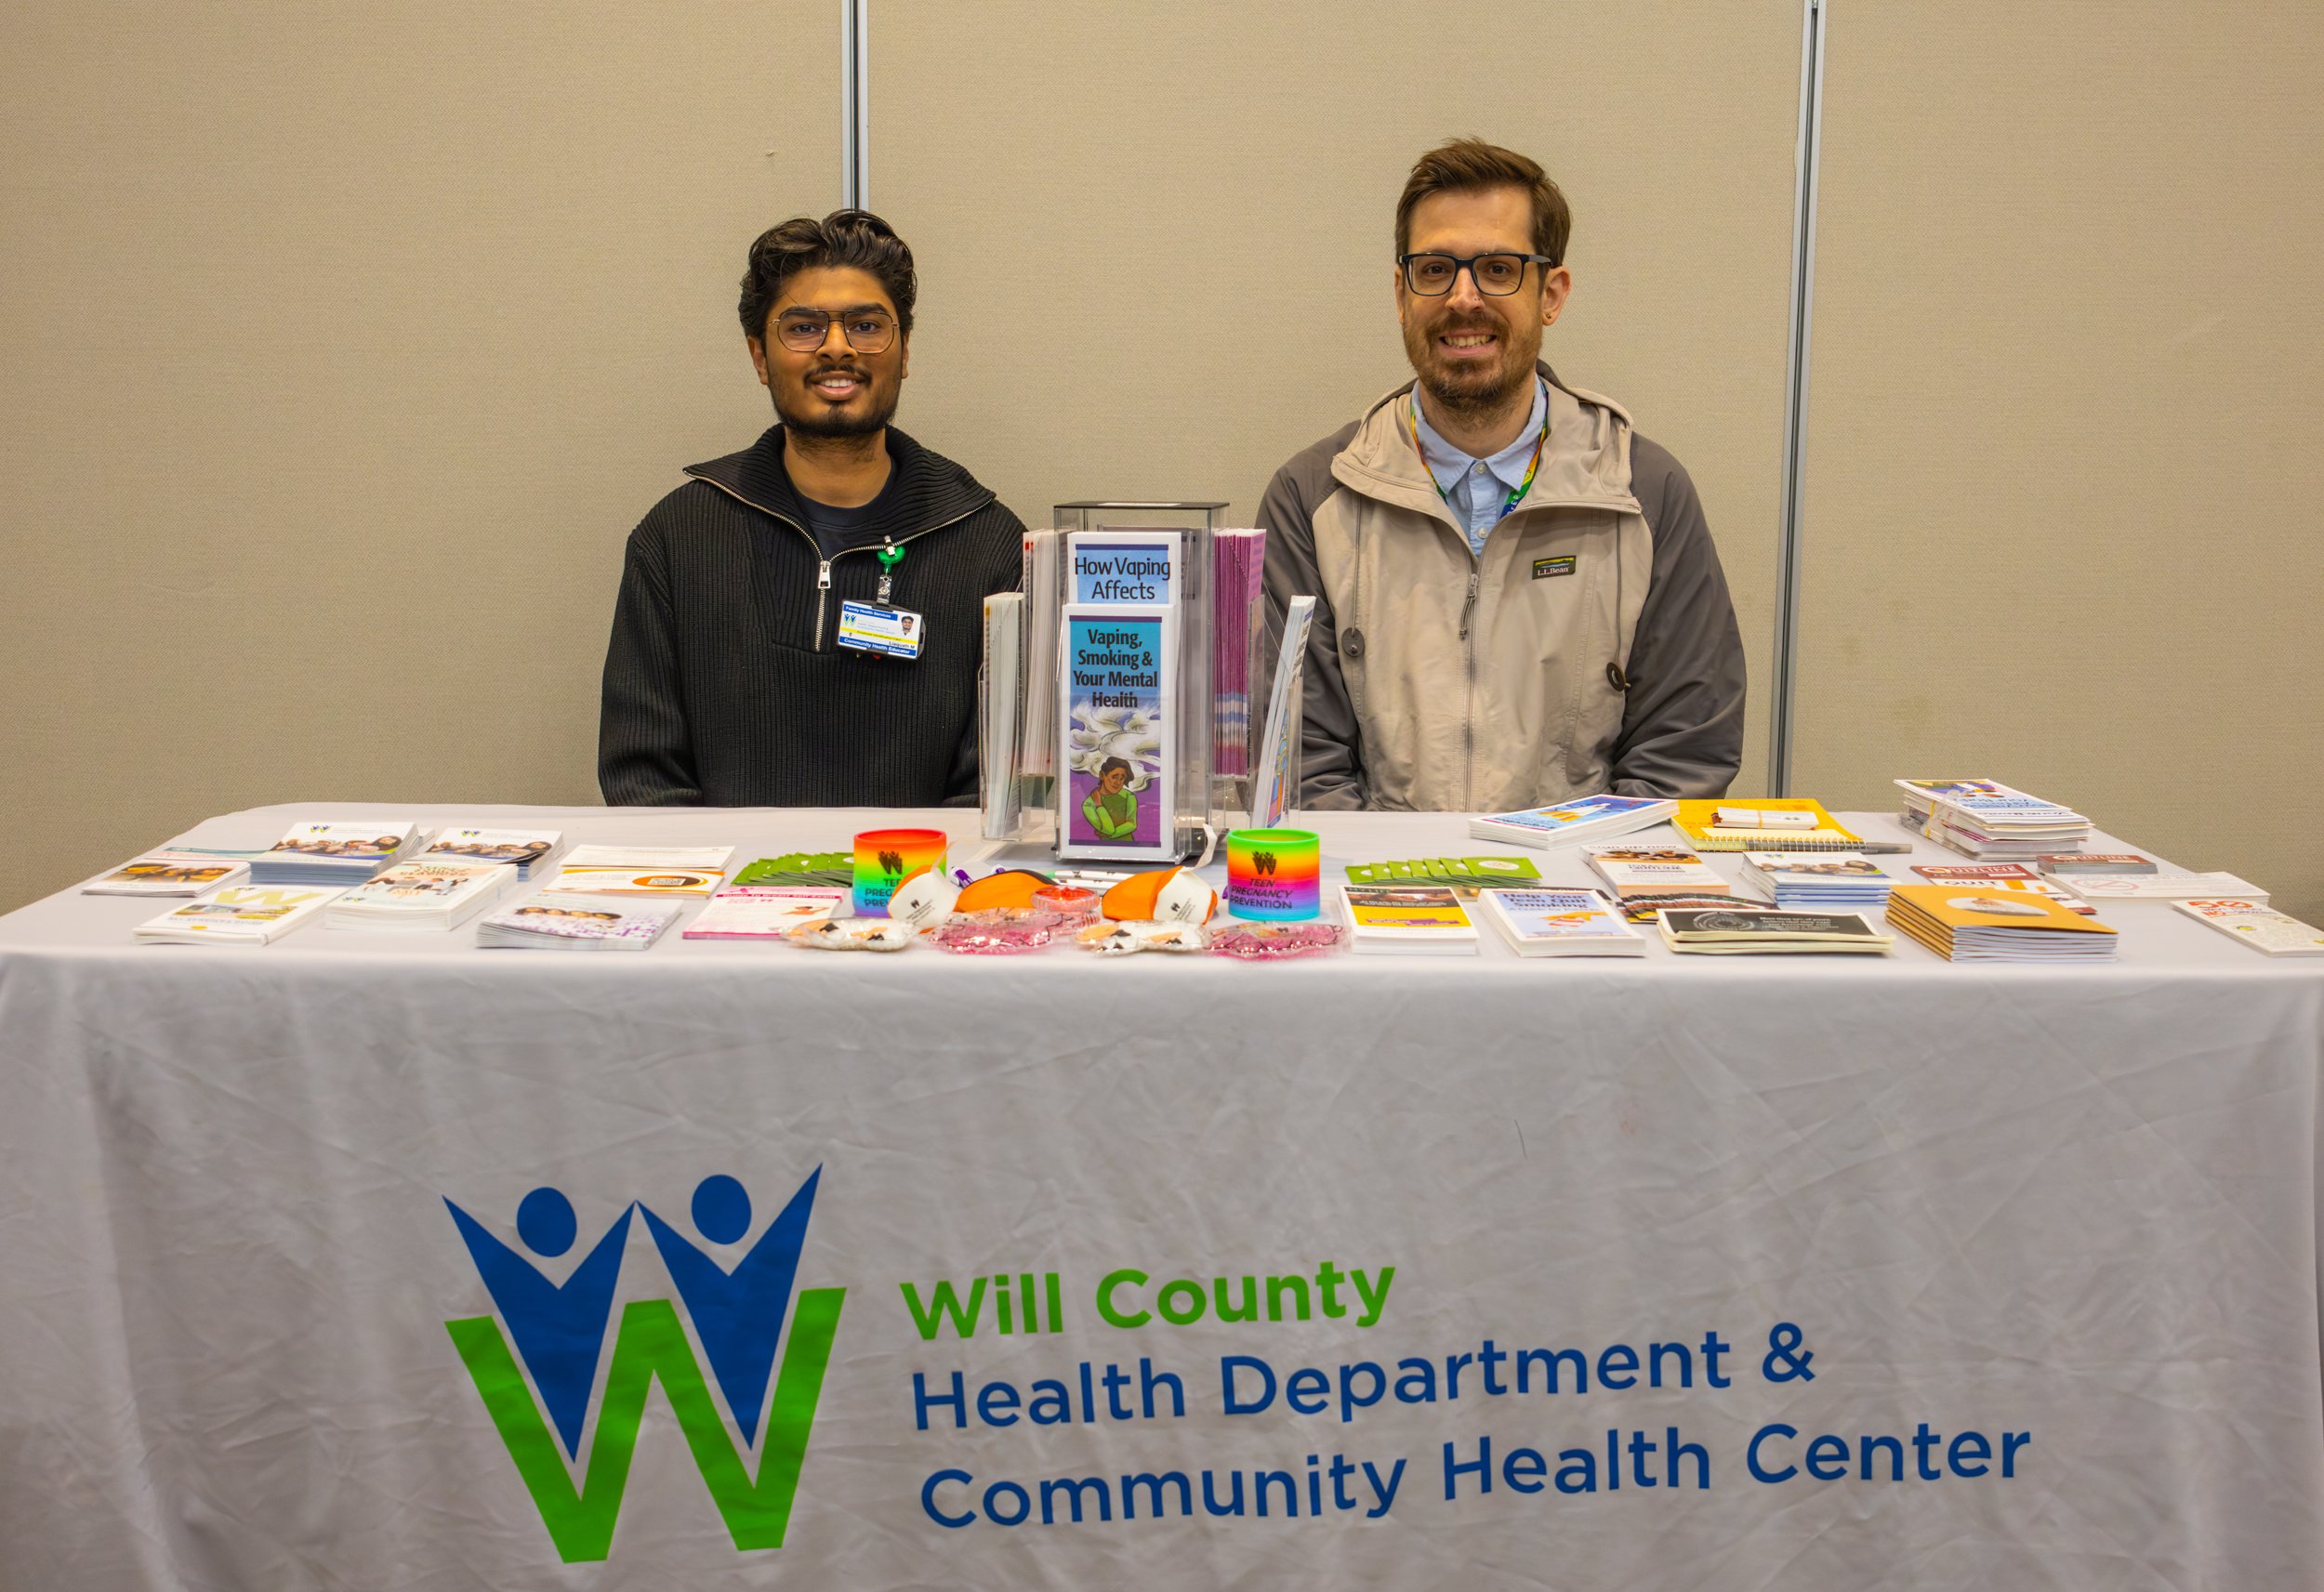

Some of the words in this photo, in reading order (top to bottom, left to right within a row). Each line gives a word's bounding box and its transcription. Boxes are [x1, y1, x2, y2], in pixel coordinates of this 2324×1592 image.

[1075, 558, 1113, 575] How
[1114, 557, 1170, 581] Vaping
[1538, 567, 1569, 576] L.L.Bean
[1091, 581, 1155, 599] Affects
[844, 638, 872, 648] Community
[1087, 629, 1142, 650] Vaping,
[1077, 650, 1140, 670] Smoking
[1142, 651, 1153, 666] &
[1073, 671, 1106, 687] Your
[1108, 671, 1158, 687] Mental
[1091, 691, 1139, 708] Health
[1248, 877, 1276, 888] TEEN
[1231, 886, 1294, 899] PREGNANCY
[1230, 895, 1293, 909] PREVENTION
[899, 1272, 1063, 1341] Will
[1096, 1261, 1395, 1328] County
[913, 1358, 1184, 1430] Health
[1221, 1331, 1731, 1423] Department
[1762, 1322, 1816, 1383] &
[921, 1454, 1406, 1529] Community
[1443, 1427, 1710, 1500] Health
[1747, 1423, 2030, 1484] Center
